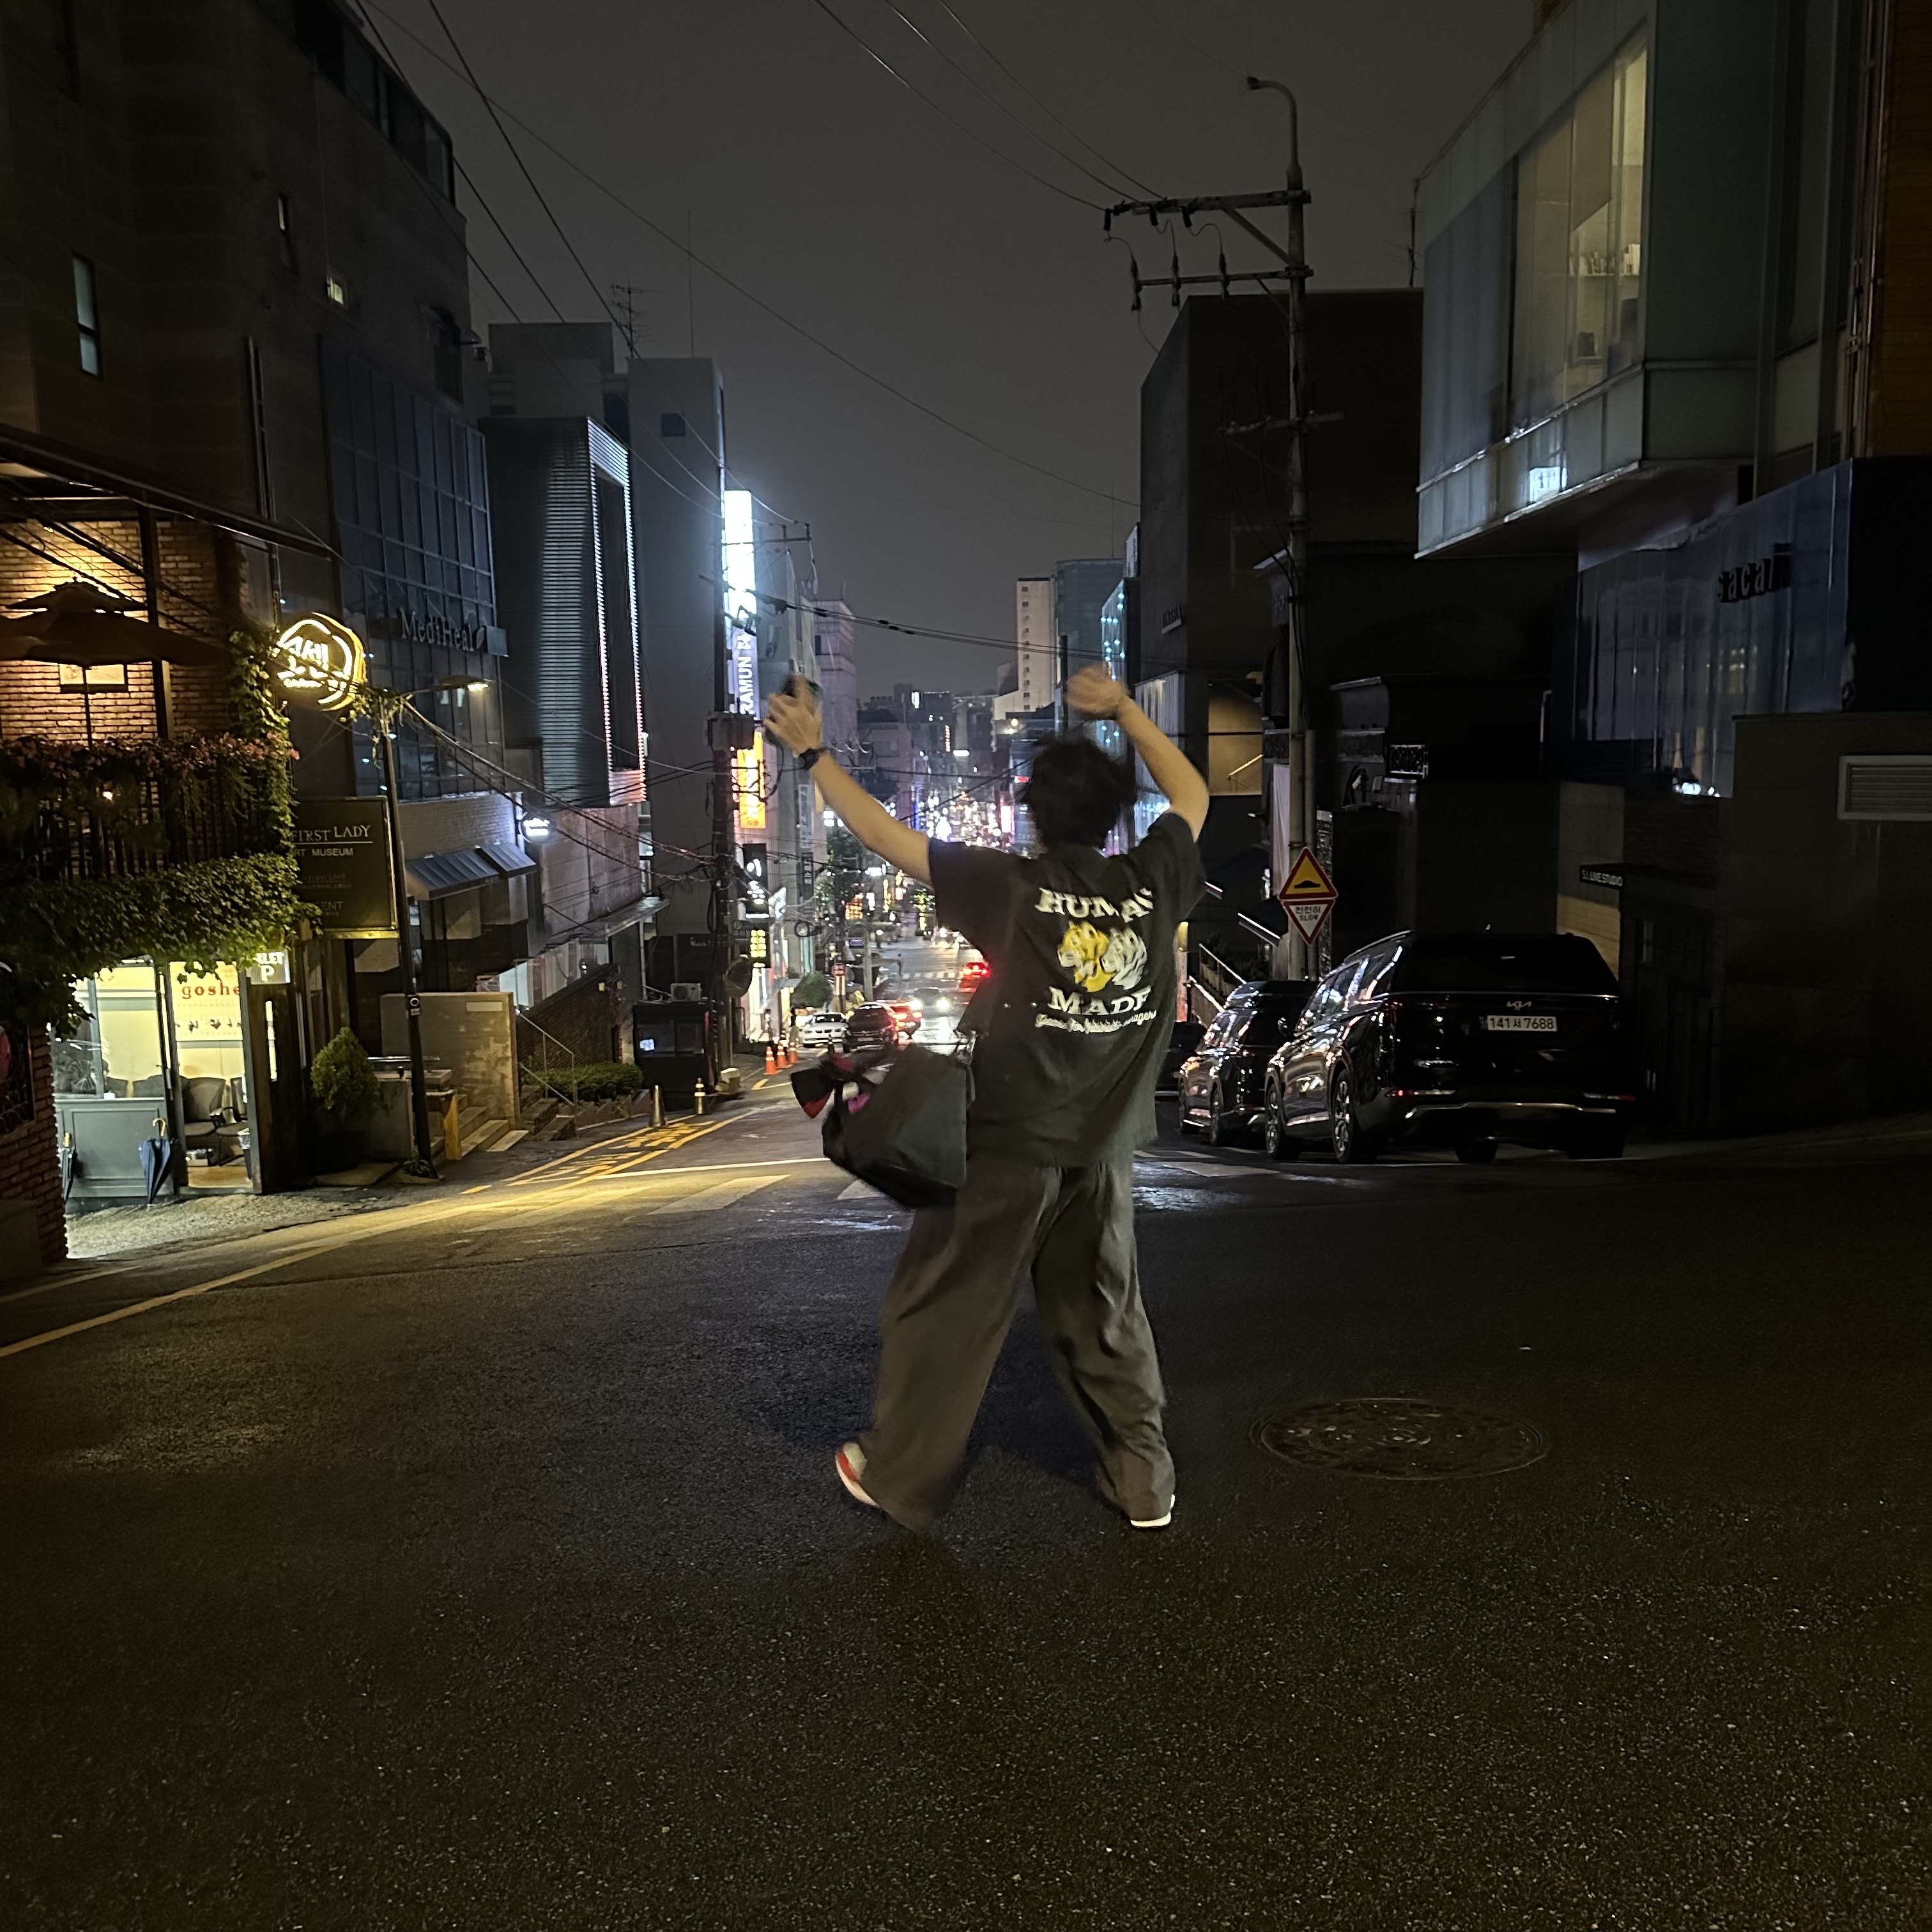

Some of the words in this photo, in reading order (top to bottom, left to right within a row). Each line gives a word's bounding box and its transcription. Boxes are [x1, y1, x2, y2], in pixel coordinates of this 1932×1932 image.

[399, 608, 475, 652] MediHeal
[333, 824, 371, 838] LADY
[311, 847, 354, 857] MUSEUM
[1296, 906, 1321, 914] 천천히
[261, 965, 275, 982] P
